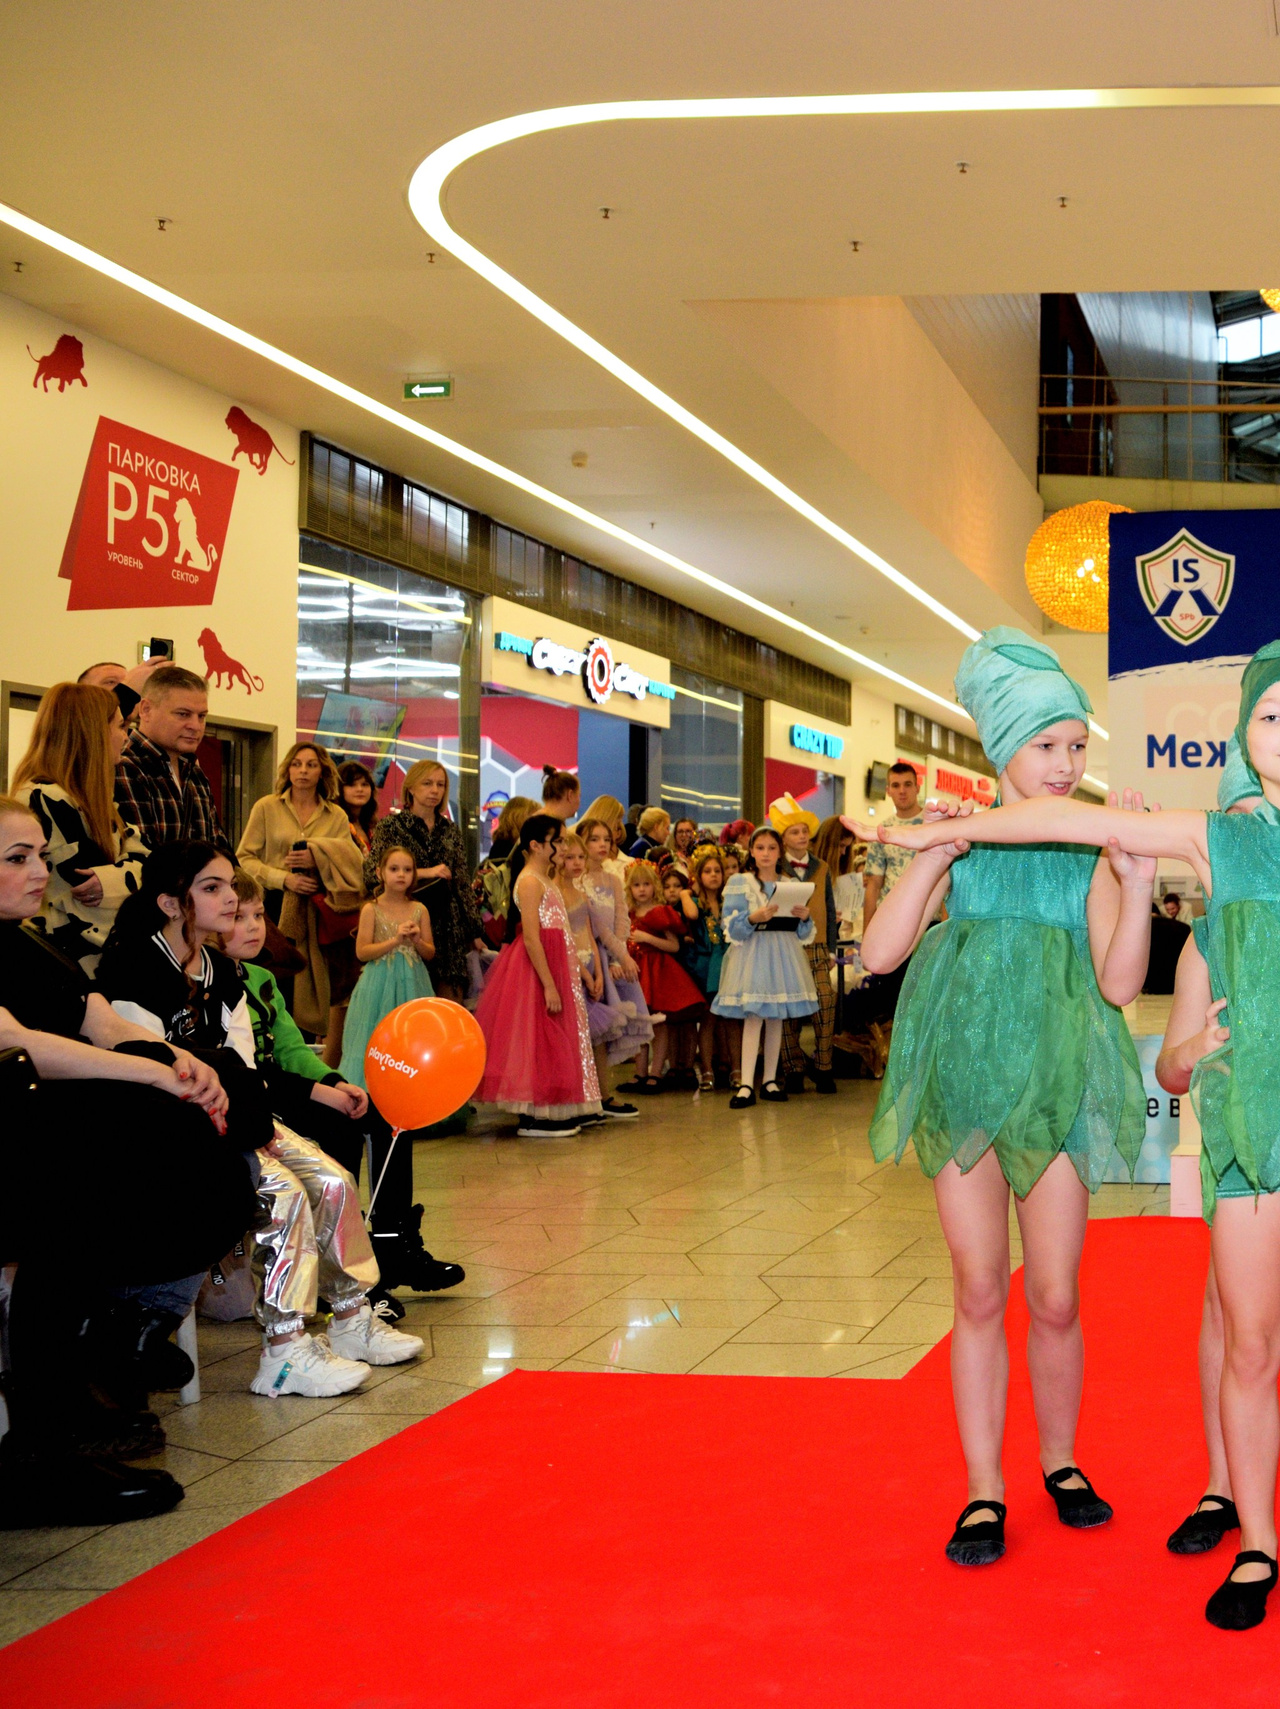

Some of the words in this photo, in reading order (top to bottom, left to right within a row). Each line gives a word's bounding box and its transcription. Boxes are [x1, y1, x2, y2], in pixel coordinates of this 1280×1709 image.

[108, 441, 201, 495] ПАРКОВКА
[107, 550, 144, 570] УРОВЕНЬ
[1172, 558, 1200, 584] IS
[171, 568, 199, 584] СЕКТОР
[367, 1046, 419, 1079] playToday
